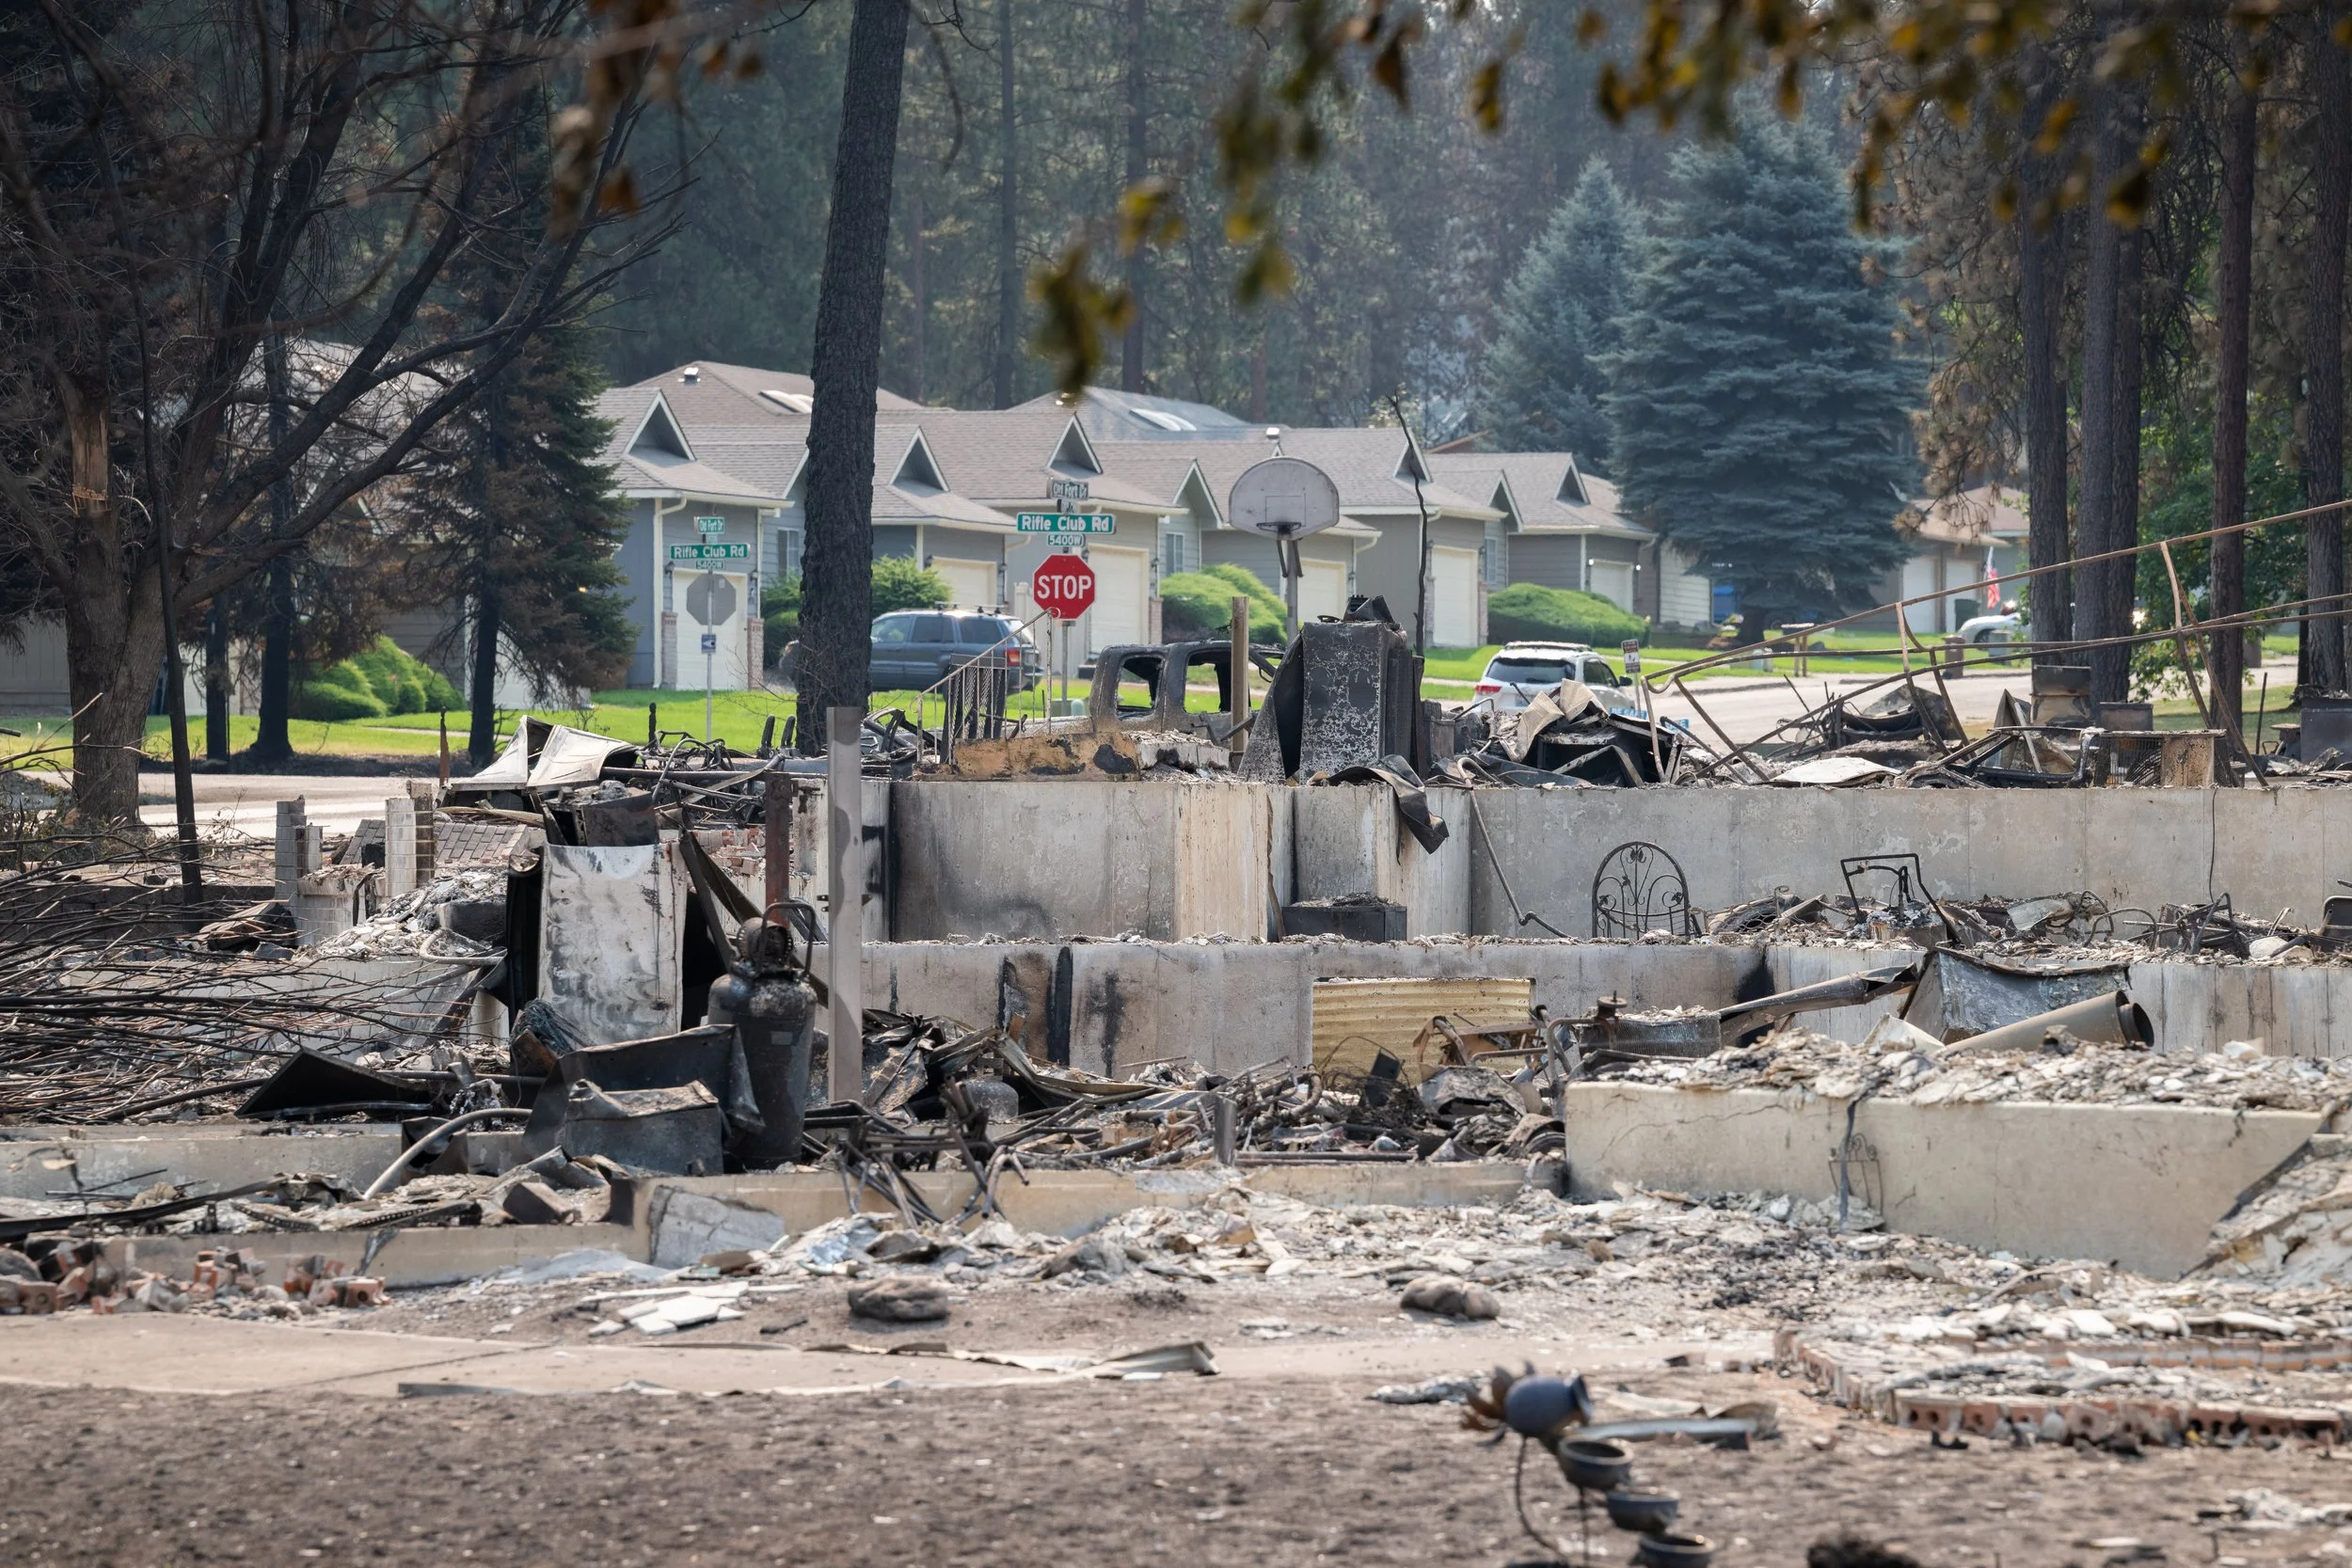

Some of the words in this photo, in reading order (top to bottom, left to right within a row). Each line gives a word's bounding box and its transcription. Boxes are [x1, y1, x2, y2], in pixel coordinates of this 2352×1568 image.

[1022, 515, 1051, 531] Rifle
[1057, 516, 1086, 531] Club
[1091, 517, 1109, 531] Rd
[1049, 534, 1082, 546] 5400W
[674, 546, 698, 559] Rifle
[703, 546, 726, 558] Club
[730, 546, 744, 557] Rd
[1037, 575, 1092, 600] STOP
